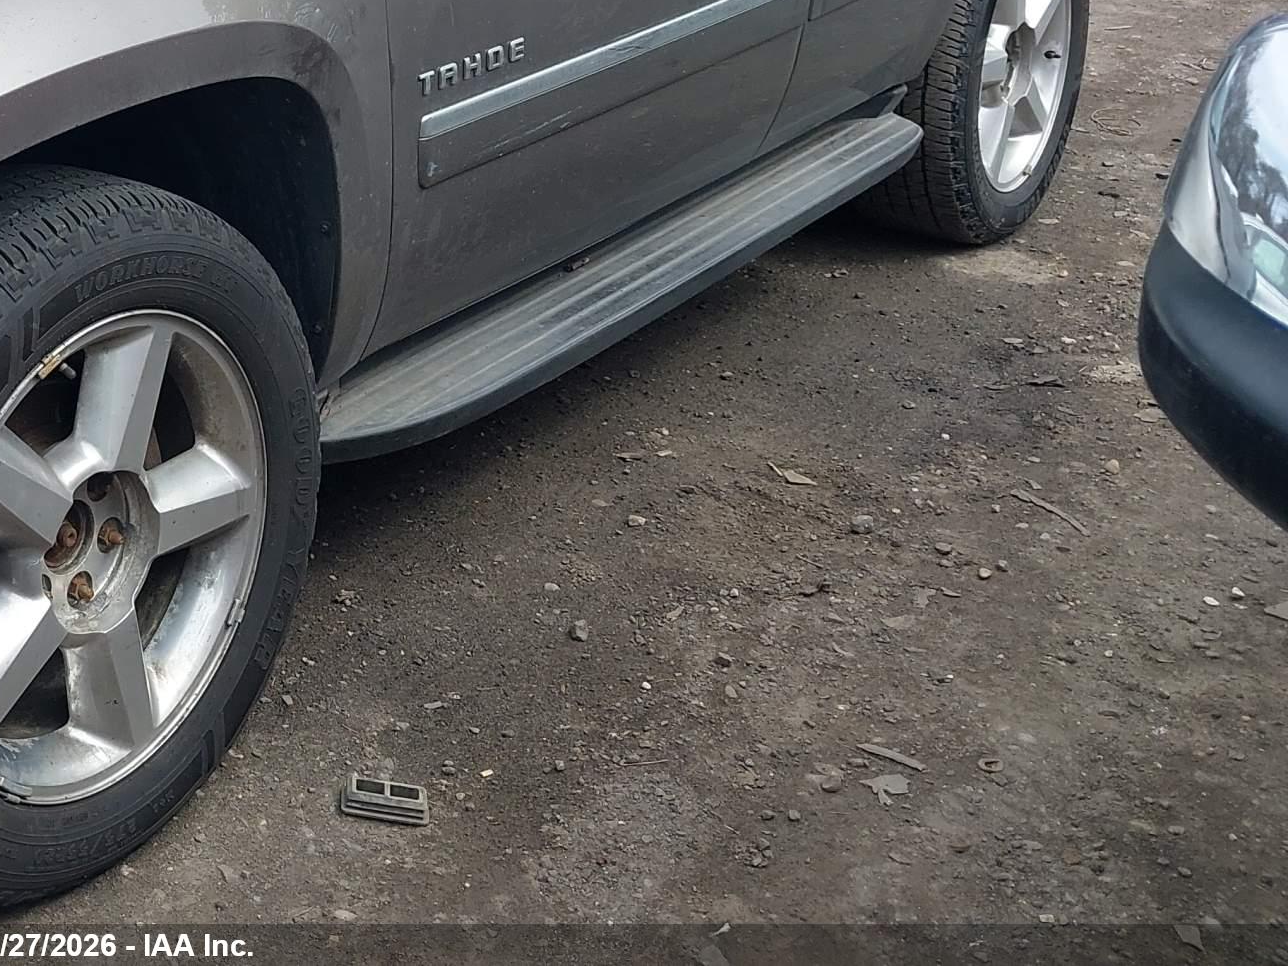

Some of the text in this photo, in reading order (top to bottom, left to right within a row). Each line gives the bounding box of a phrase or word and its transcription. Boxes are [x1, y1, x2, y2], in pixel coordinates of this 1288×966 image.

[417, 37, 525, 96] TAHOE
[74, 255, 209, 303] WORKHORSE
[253, 387, 312, 672] GOODYEAR
